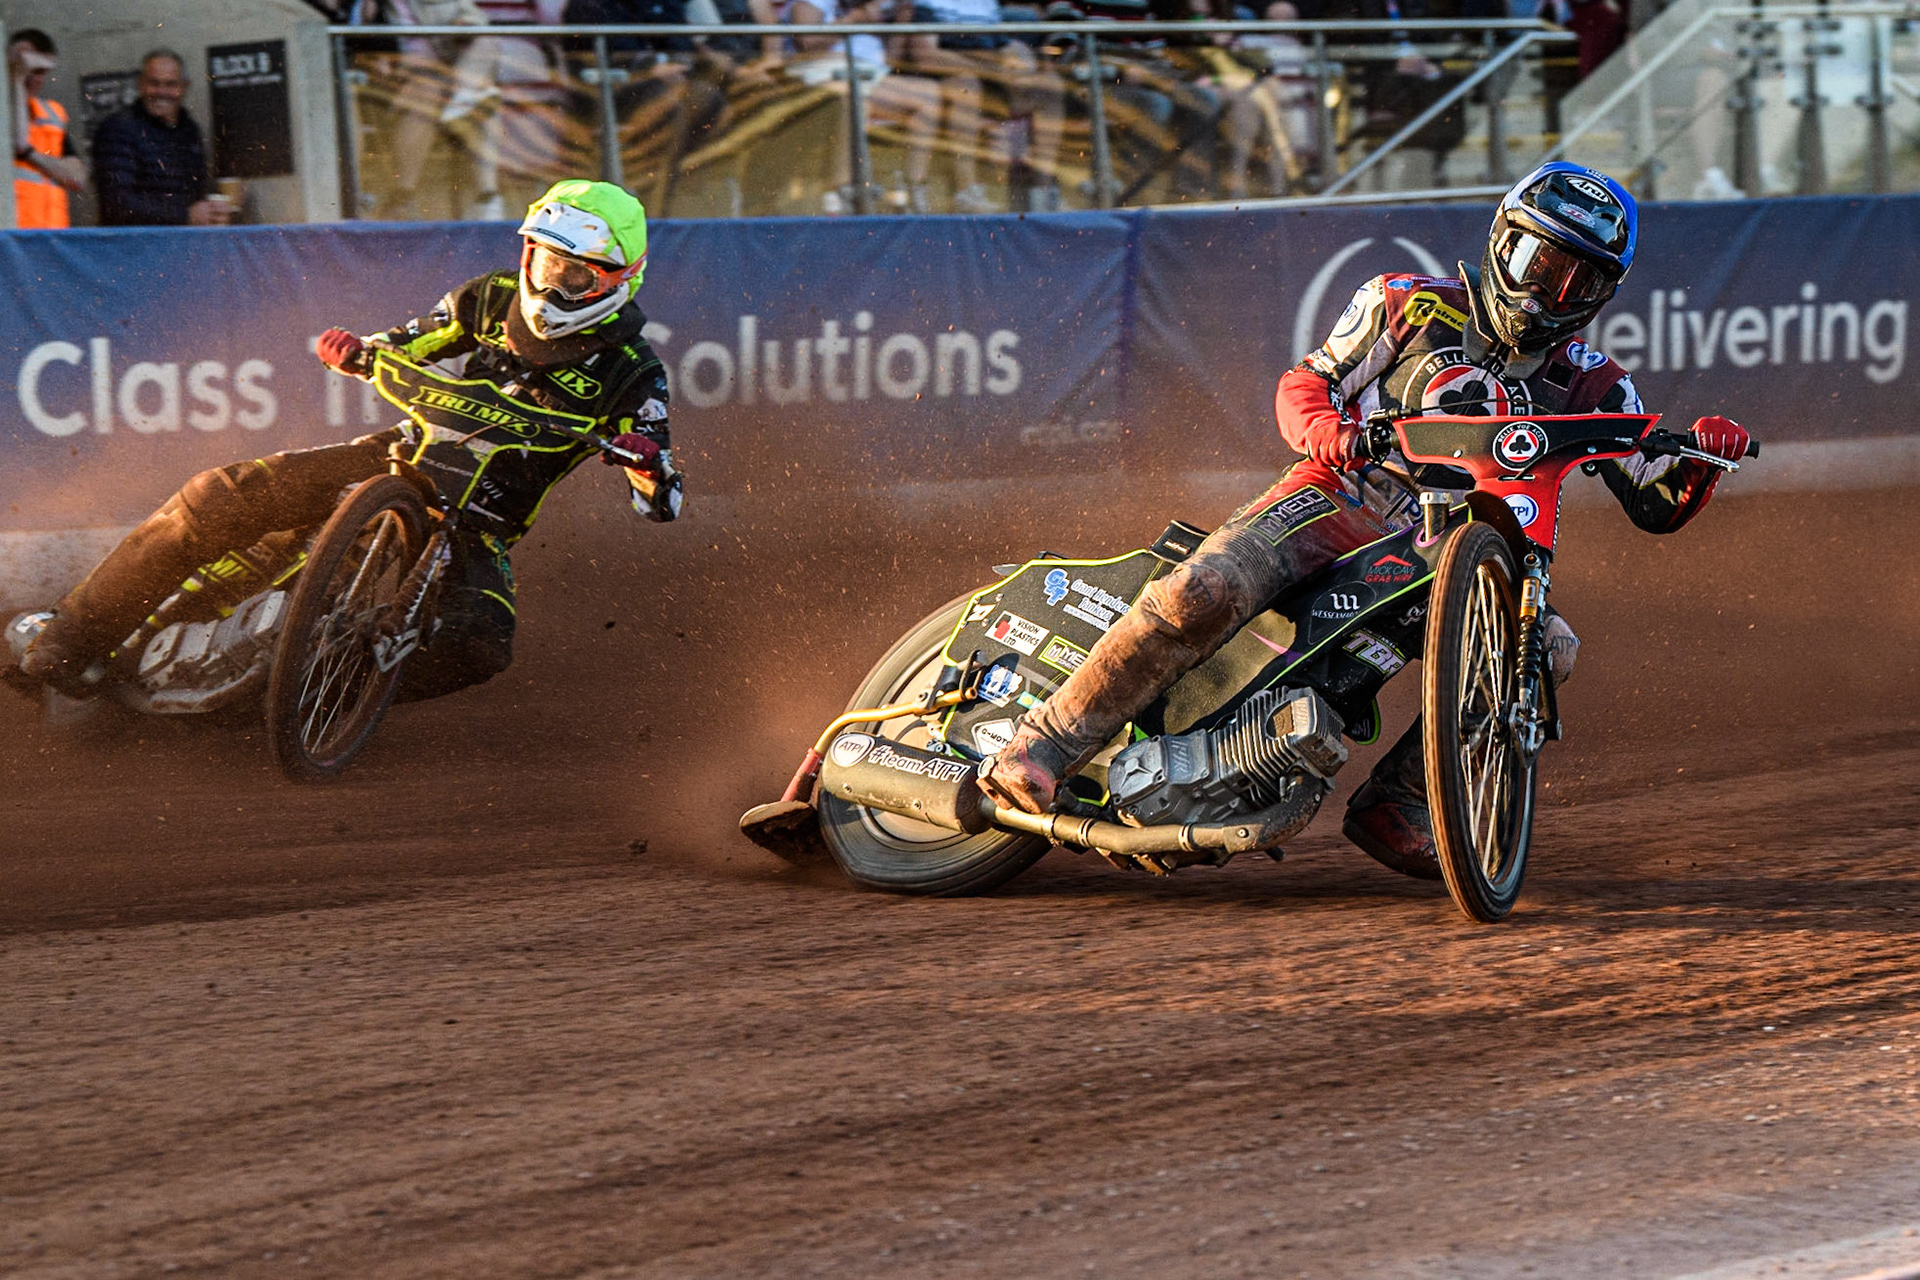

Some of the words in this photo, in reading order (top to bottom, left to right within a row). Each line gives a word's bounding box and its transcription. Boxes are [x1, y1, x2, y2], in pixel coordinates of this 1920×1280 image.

[1413, 298, 1464, 327] Rentruc
[1587, 282, 1908, 384] elivering
[17, 337, 277, 437] Class
[1425, 353, 1471, 375] BELLE
[1507, 386, 1526, 415] ACE
[425, 391, 475, 413] TRU
[1498, 426, 1515, 442] BELLE
[1532, 428, 1545, 442] ACES
[1364, 574, 1392, 583] GRAB
[1367, 565, 1393, 576] MICK
[1393, 565, 1417, 575] CAVE
[1071, 579, 1098, 600] Grant
[1092, 588, 1132, 616] Henders
[1078, 597, 1115, 621] Tankers
[1010, 628, 1041, 647] PLASTICS
[1017, 620, 1041, 634] VISION
[1003, 636, 1017, 647] LTD
[839, 741, 865, 754] ATPI
[868, 745, 971, 784] #teamATPI
